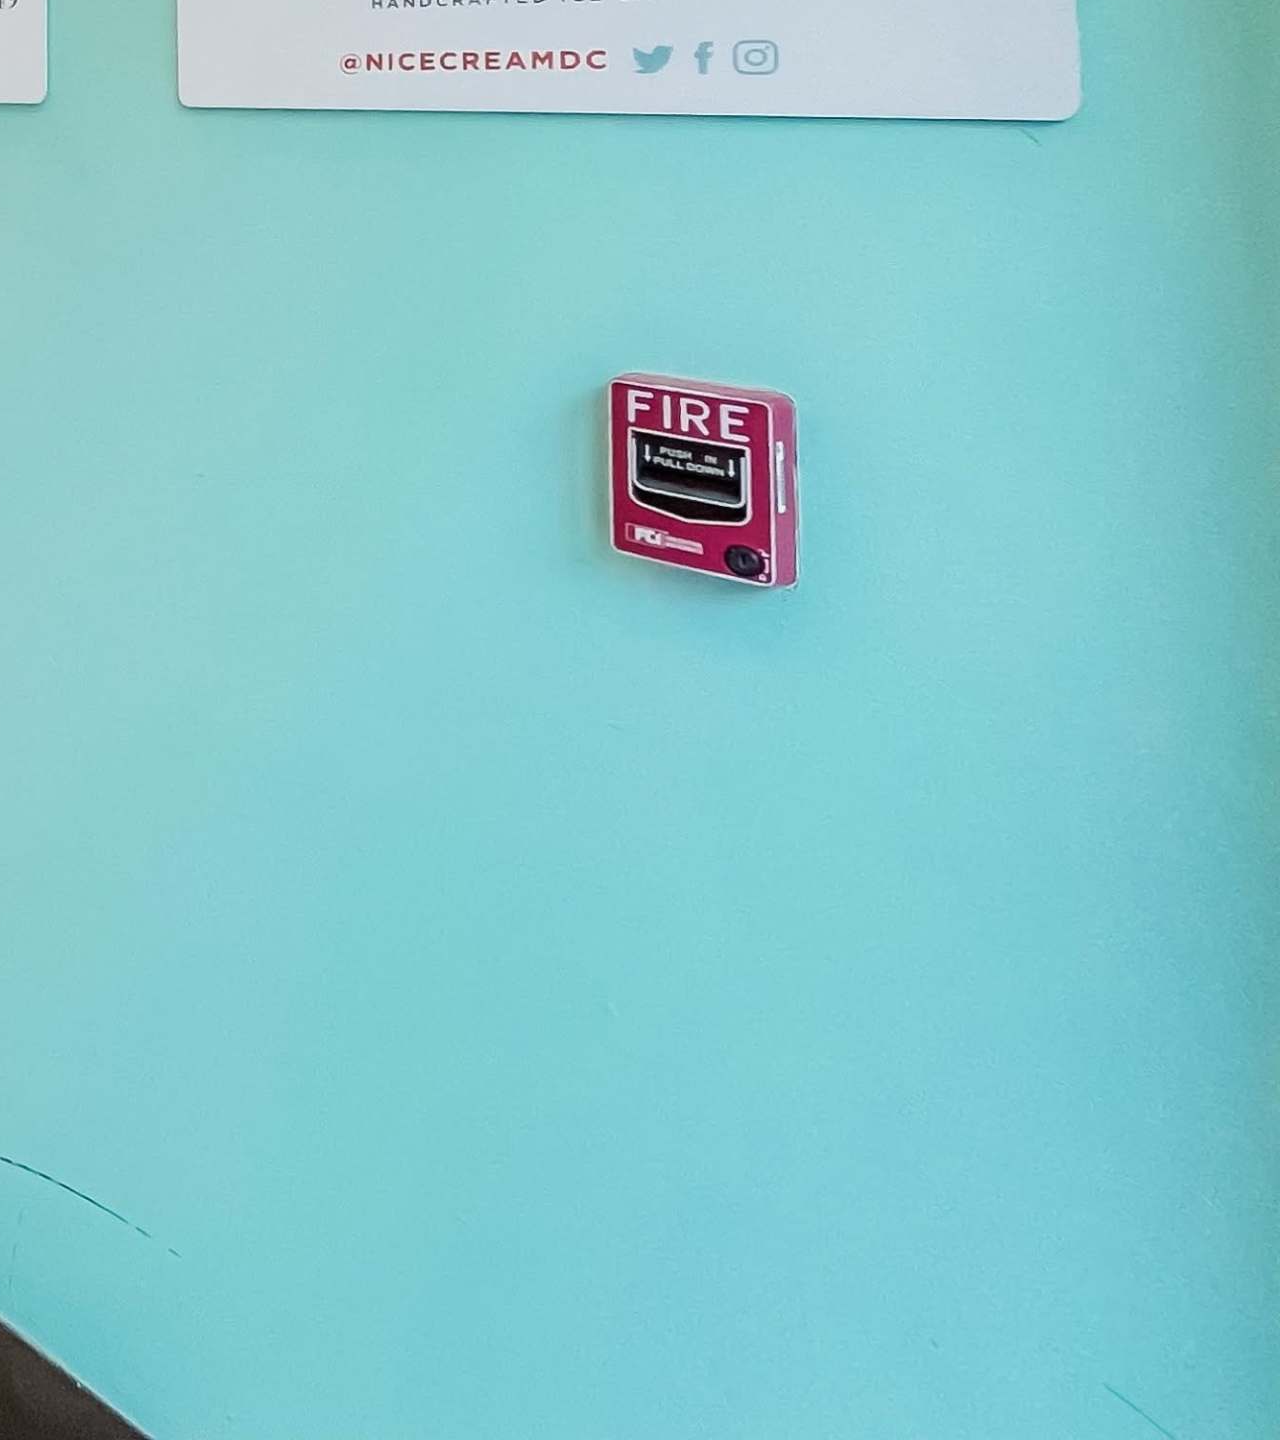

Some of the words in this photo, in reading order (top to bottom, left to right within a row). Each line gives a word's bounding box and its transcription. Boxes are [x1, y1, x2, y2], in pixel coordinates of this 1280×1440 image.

[339, 48, 608, 75] @NICECREAMDC
[627, 389, 750, 443] FIRE
[659, 446, 692, 460] PUSH
[653, 456, 684, 472] PULL
[686, 462, 725, 478] DOWN
